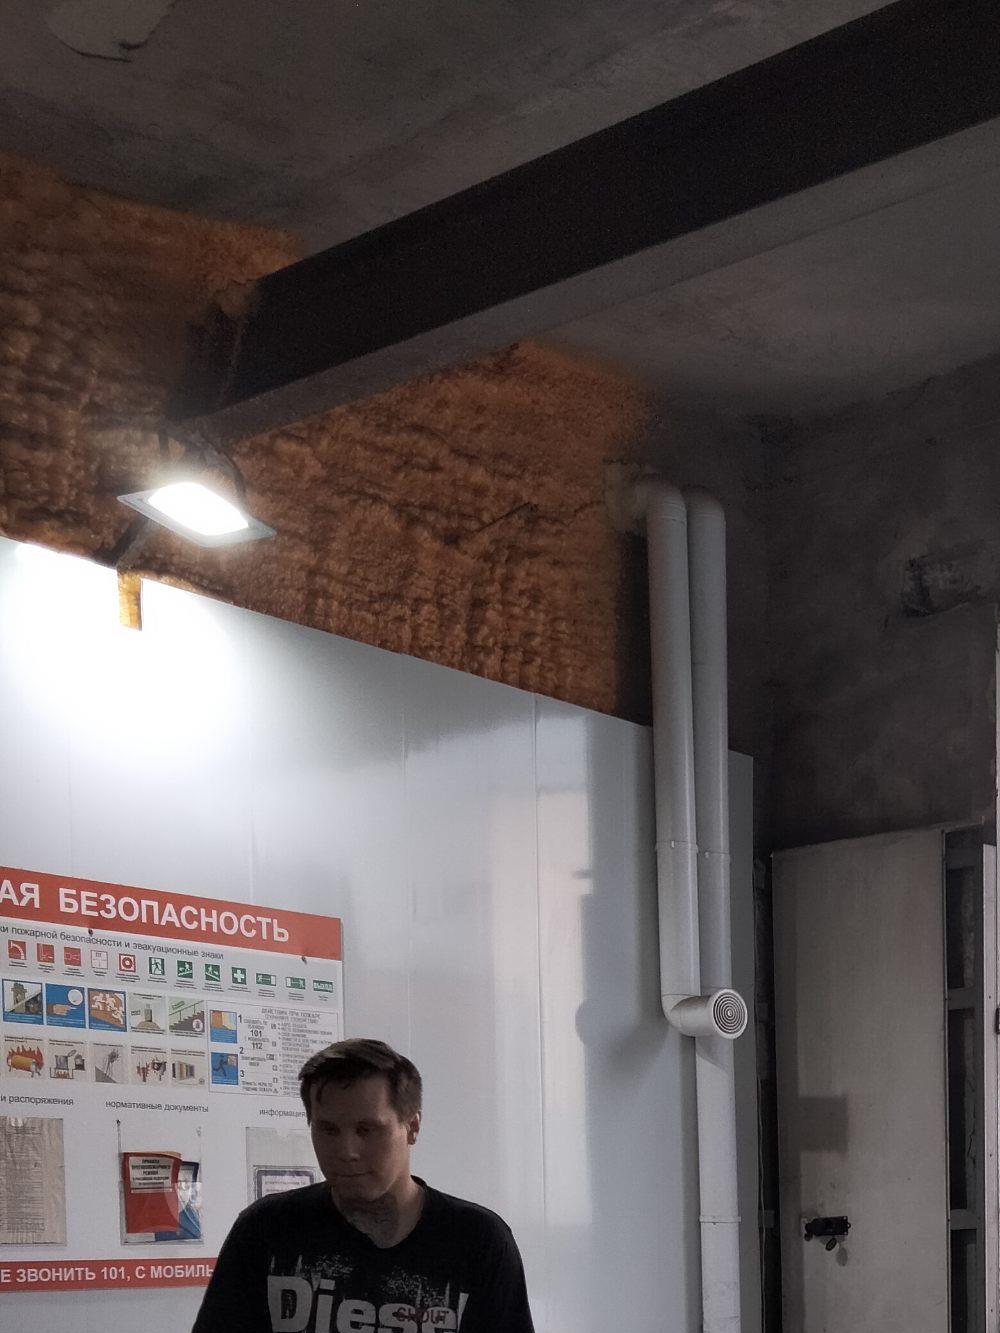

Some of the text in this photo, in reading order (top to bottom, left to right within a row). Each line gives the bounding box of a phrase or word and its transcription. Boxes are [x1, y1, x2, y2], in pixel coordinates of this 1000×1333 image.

[0, 879, 289, 942] АЯ БЕЗОПАСНОСТЬ
[12, 926, 58, 940] пожарной
[60, 931, 122, 948] безопасности
[133, 942, 199, 957] эвакуационные
[201, 951, 224, 960] знаки
[9, 1095, 74, 1106] распоряжения
[105, 1101, 209, 1113] нормативные документы
[0, 1269, 11, 1283] Е
[16, 1268, 96, 1283] ЗВОНИТЬ
[101, 1266, 131, 1282] 101,
[135, 1266, 146, 1279] С
